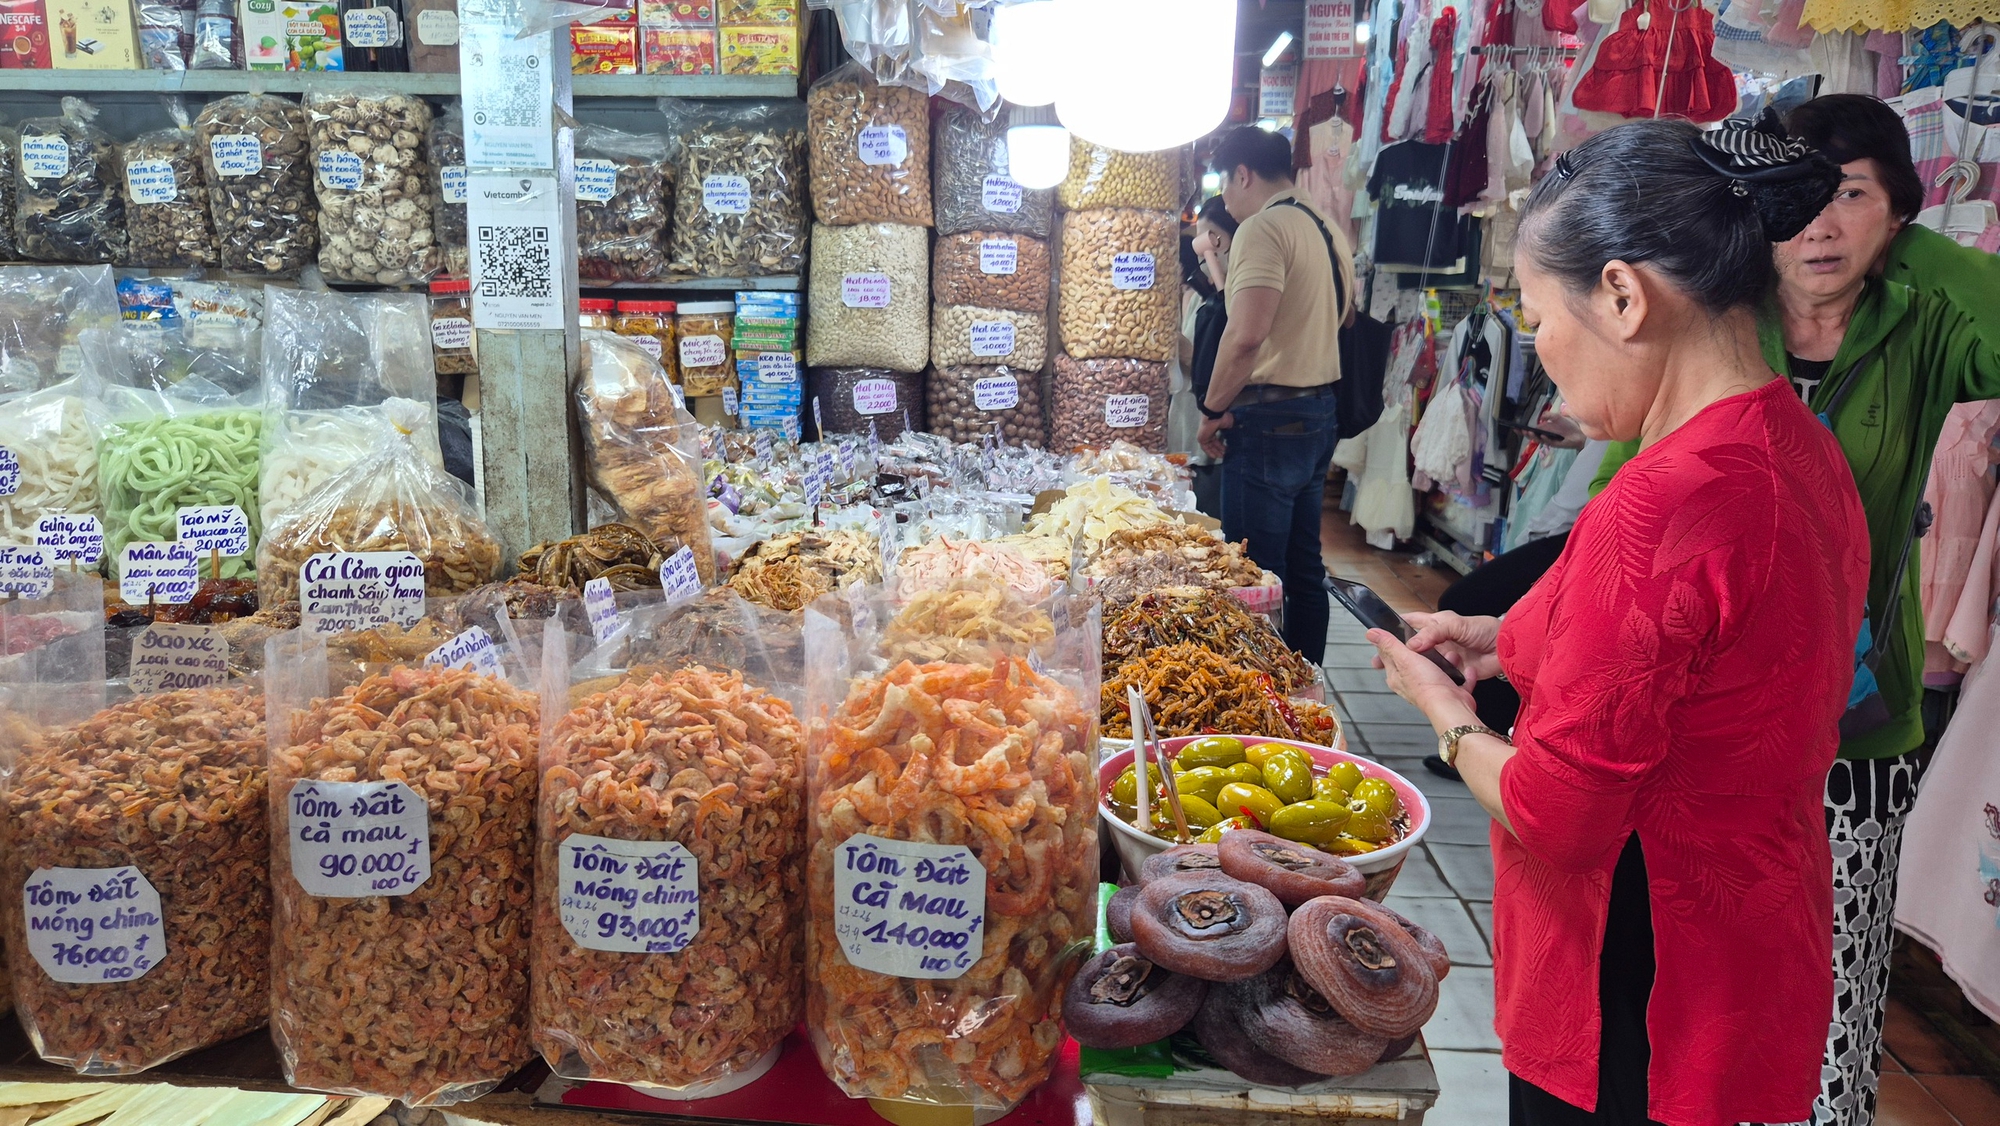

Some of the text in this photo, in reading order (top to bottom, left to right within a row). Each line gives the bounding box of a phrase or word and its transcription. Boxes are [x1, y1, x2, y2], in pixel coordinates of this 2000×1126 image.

[249, 1, 272, 11] Cozy
[79, 517, 95, 533] củ
[180, 508, 234, 526] Táo Mỹ
[68, 535, 88, 549] ong
[156, 568, 176, 577] cao
[305, 553, 336, 583] Cá
[175, 656, 200, 667] cao
[294, 784, 406, 818] Tôm Đất
[571, 844, 686, 882] Tôm Đất
[846, 843, 970, 885] Tôm Đất
[26, 869, 139, 906] Tôm Đất
[574, 878, 699, 910] Móng chim
[852, 881, 968, 919] Cà Mau
[31, 907, 159, 941] Móng chim
